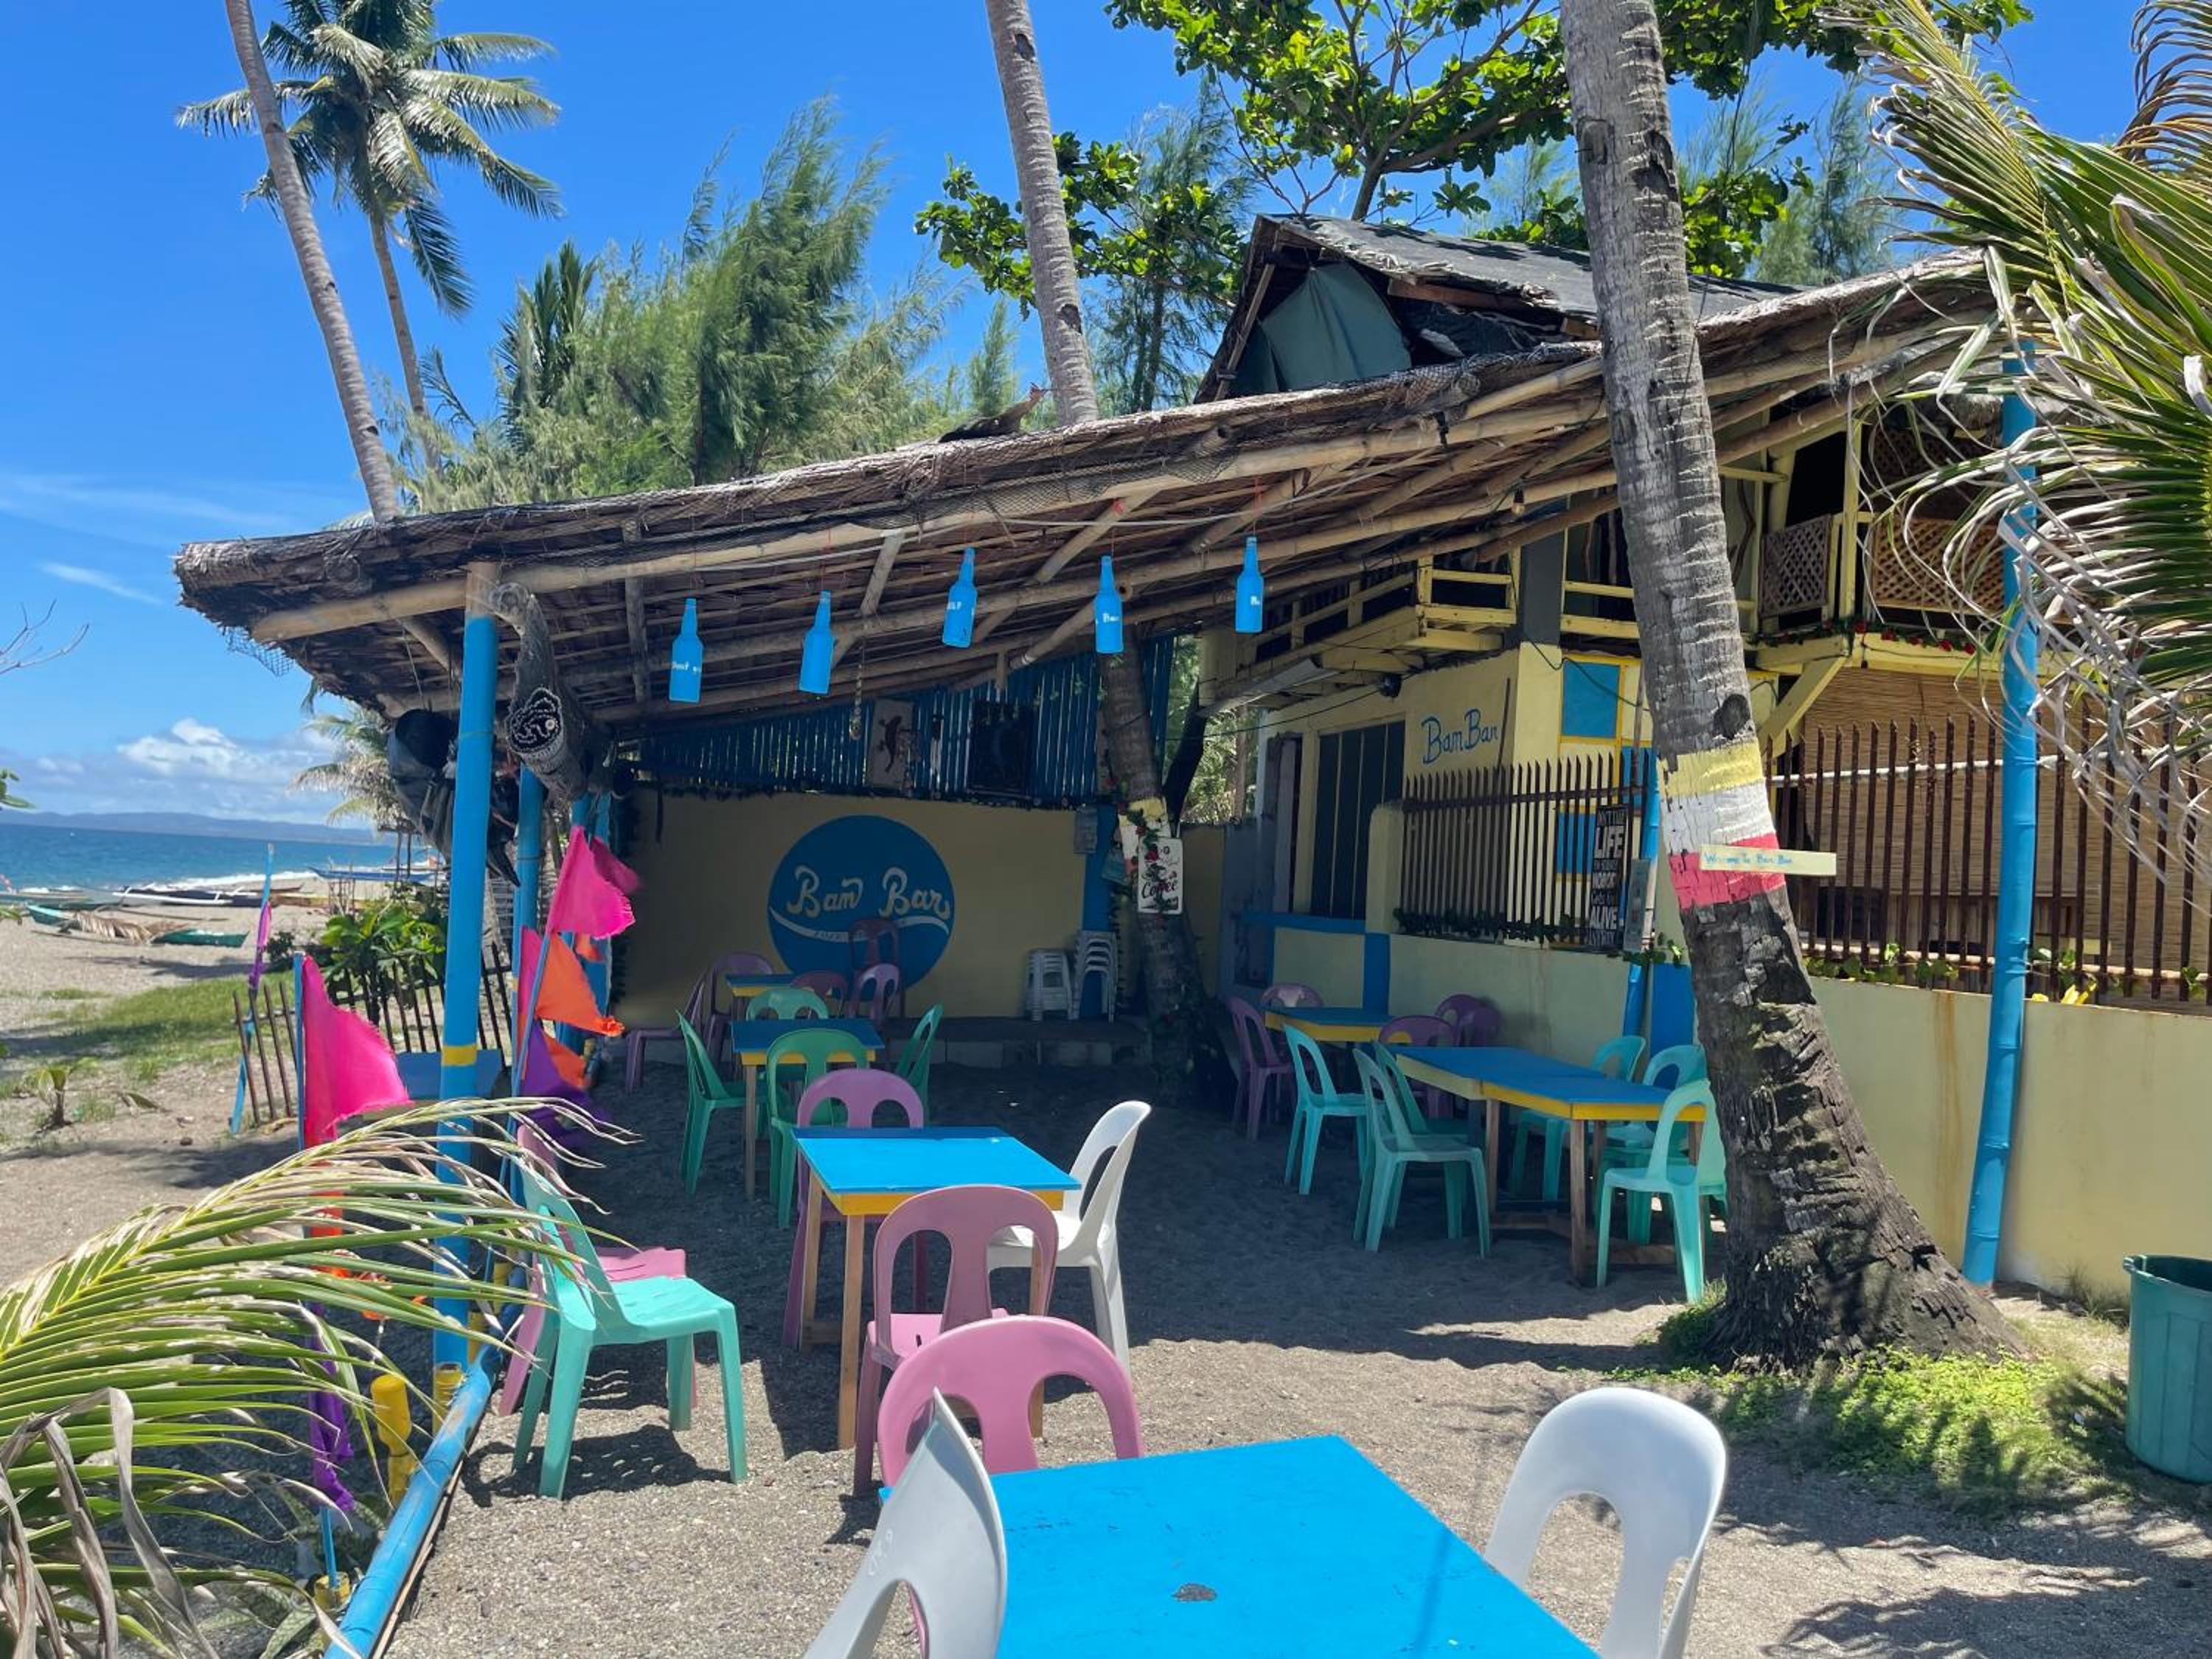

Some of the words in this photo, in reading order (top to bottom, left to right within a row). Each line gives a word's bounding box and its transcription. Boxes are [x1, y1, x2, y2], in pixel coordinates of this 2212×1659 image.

[1593, 825, 1624, 859] LIFE
[787, 865, 863, 917] Bam
[878, 866, 951, 919] Bar
[1589, 905, 1618, 930] ALIVE
